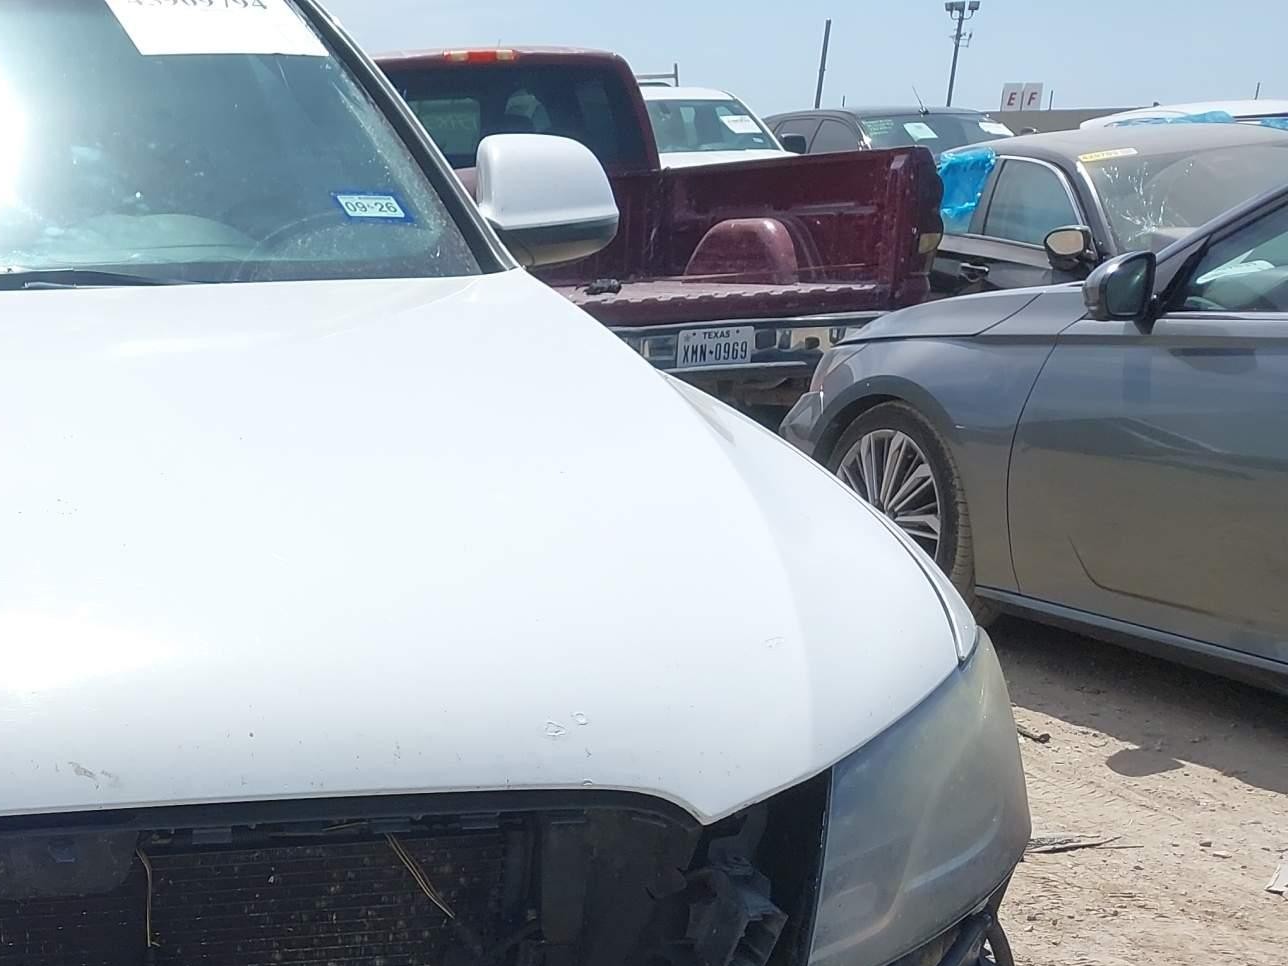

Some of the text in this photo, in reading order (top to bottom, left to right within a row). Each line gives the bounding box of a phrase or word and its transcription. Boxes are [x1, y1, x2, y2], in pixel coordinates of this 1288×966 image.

[1007, 92, 1017, 106] E
[1027, 92, 1038, 106] F
[703, 330, 731, 340] TEXAS
